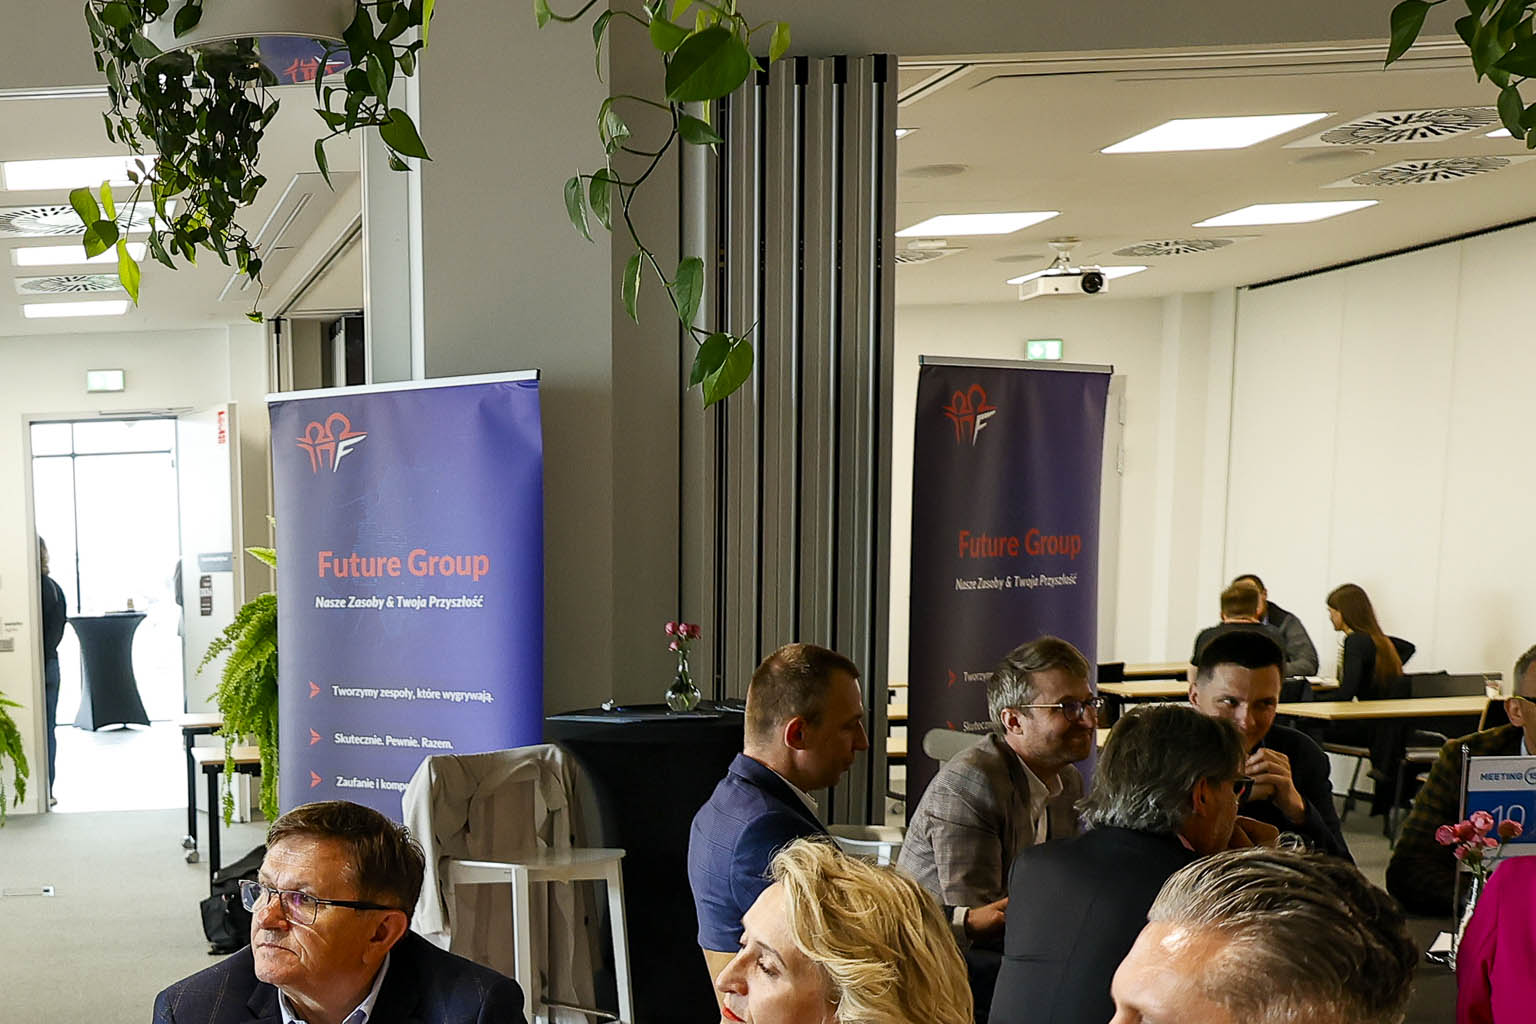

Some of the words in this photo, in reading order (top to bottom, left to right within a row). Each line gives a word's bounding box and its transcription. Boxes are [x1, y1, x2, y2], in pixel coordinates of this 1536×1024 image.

[958, 529, 1021, 559] Future
[1024, 527, 1083, 561] Group
[317, 550, 402, 578] Future
[407, 548, 491, 582] Group
[955, 577, 977, 591] Nasze
[977, 576, 1004, 591] Zasoby
[1014, 574, 1038, 589] Twoja
[315, 595, 347, 610] Nasze
[348, 595, 385, 611] Zasoby
[386, 597, 394, 609] &
[396, 596, 427, 611] Twoja
[428, 594, 484, 611] Przyszłość
[331, 685, 378, 700] Tworzymy
[379, 687, 415, 701] zespoły,
[416, 687, 441, 700] które
[442, 690, 495, 704] wygrywają.
[333, 732, 385, 747] Skutecznie.
[385, 735, 421, 748] Pewnie.
[421, 736, 454, 750] Razem.
[336, 776, 375, 790] Zaufanie
[380, 779, 409, 794] kompe
[1479, 772, 1523, 781] MEETING
